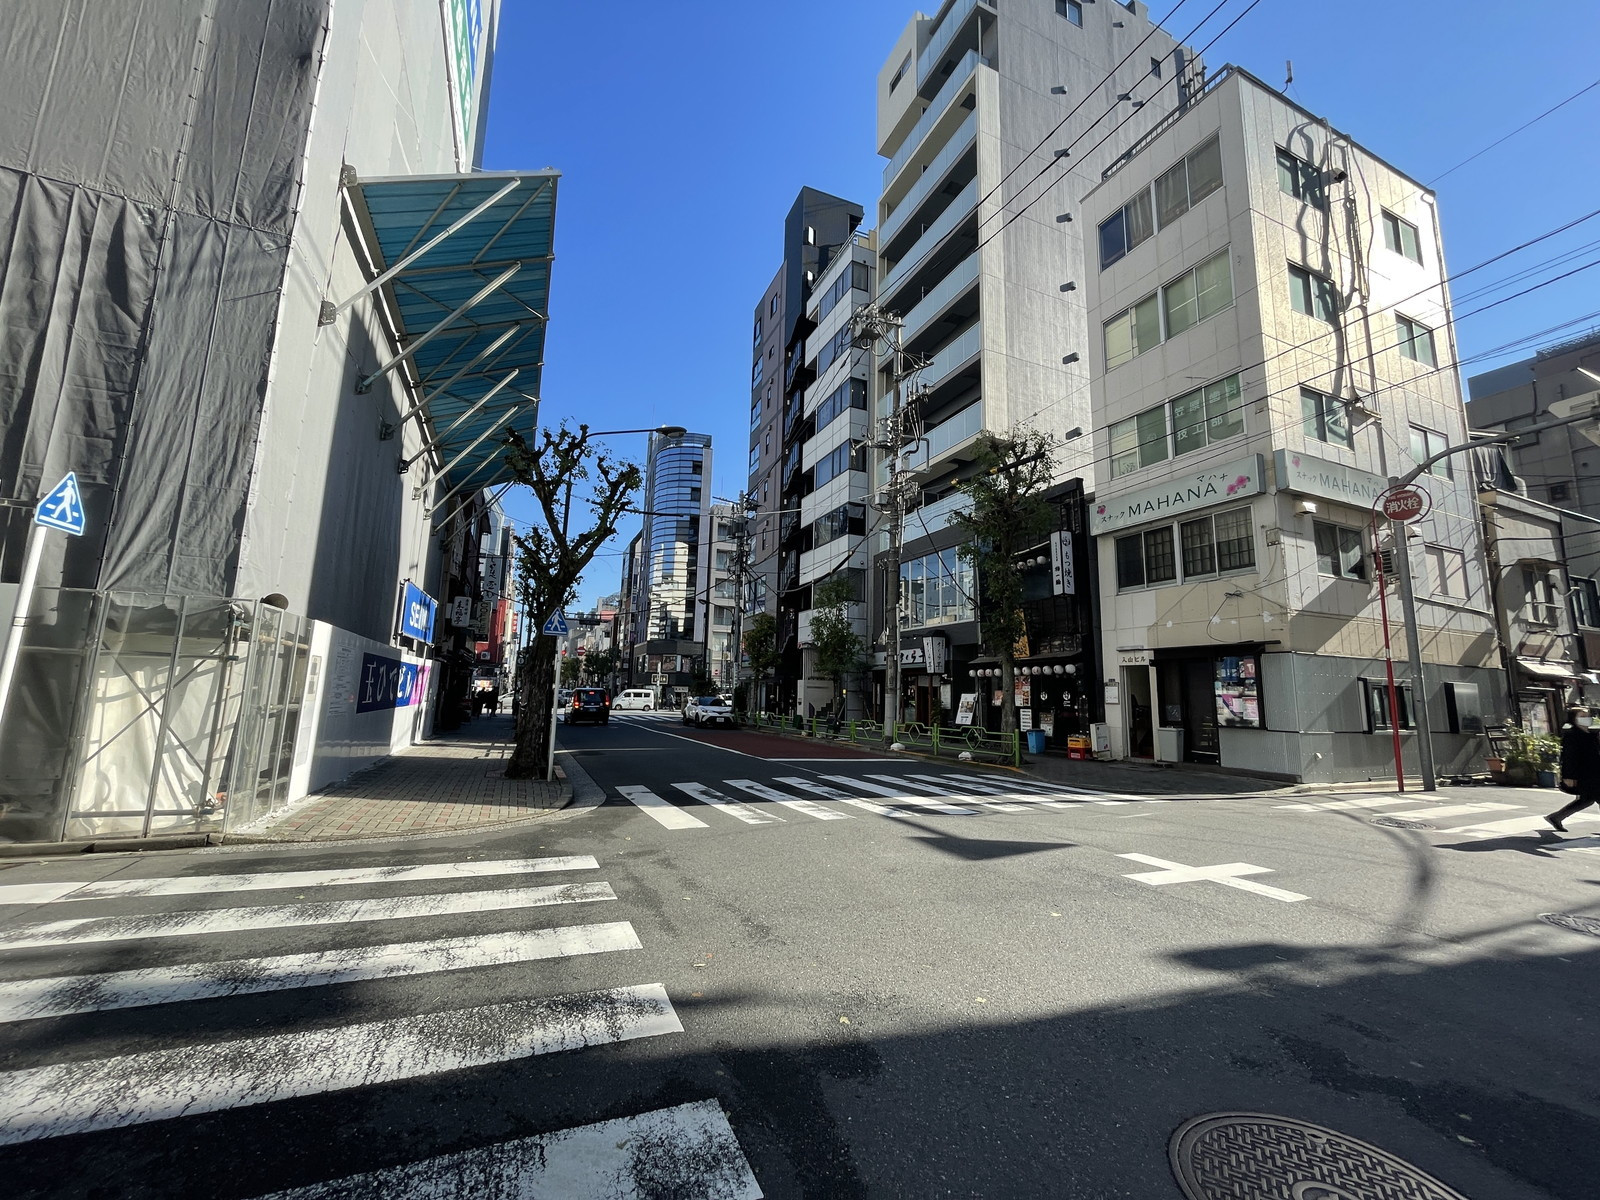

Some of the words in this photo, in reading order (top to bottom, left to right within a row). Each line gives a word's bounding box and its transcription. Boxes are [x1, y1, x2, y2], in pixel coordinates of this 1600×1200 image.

[1197, 473, 1228, 482] マハナ
[1296, 471, 1317, 483] スナック
[1319, 473, 1379, 500] MAHANA
[1101, 511, 1125, 524] スナック
[1128, 482, 1217, 518] MAHANA
[1386, 496, 1421, 514] 消火栓
[1064, 551, 1073, 588] もつ焼き
